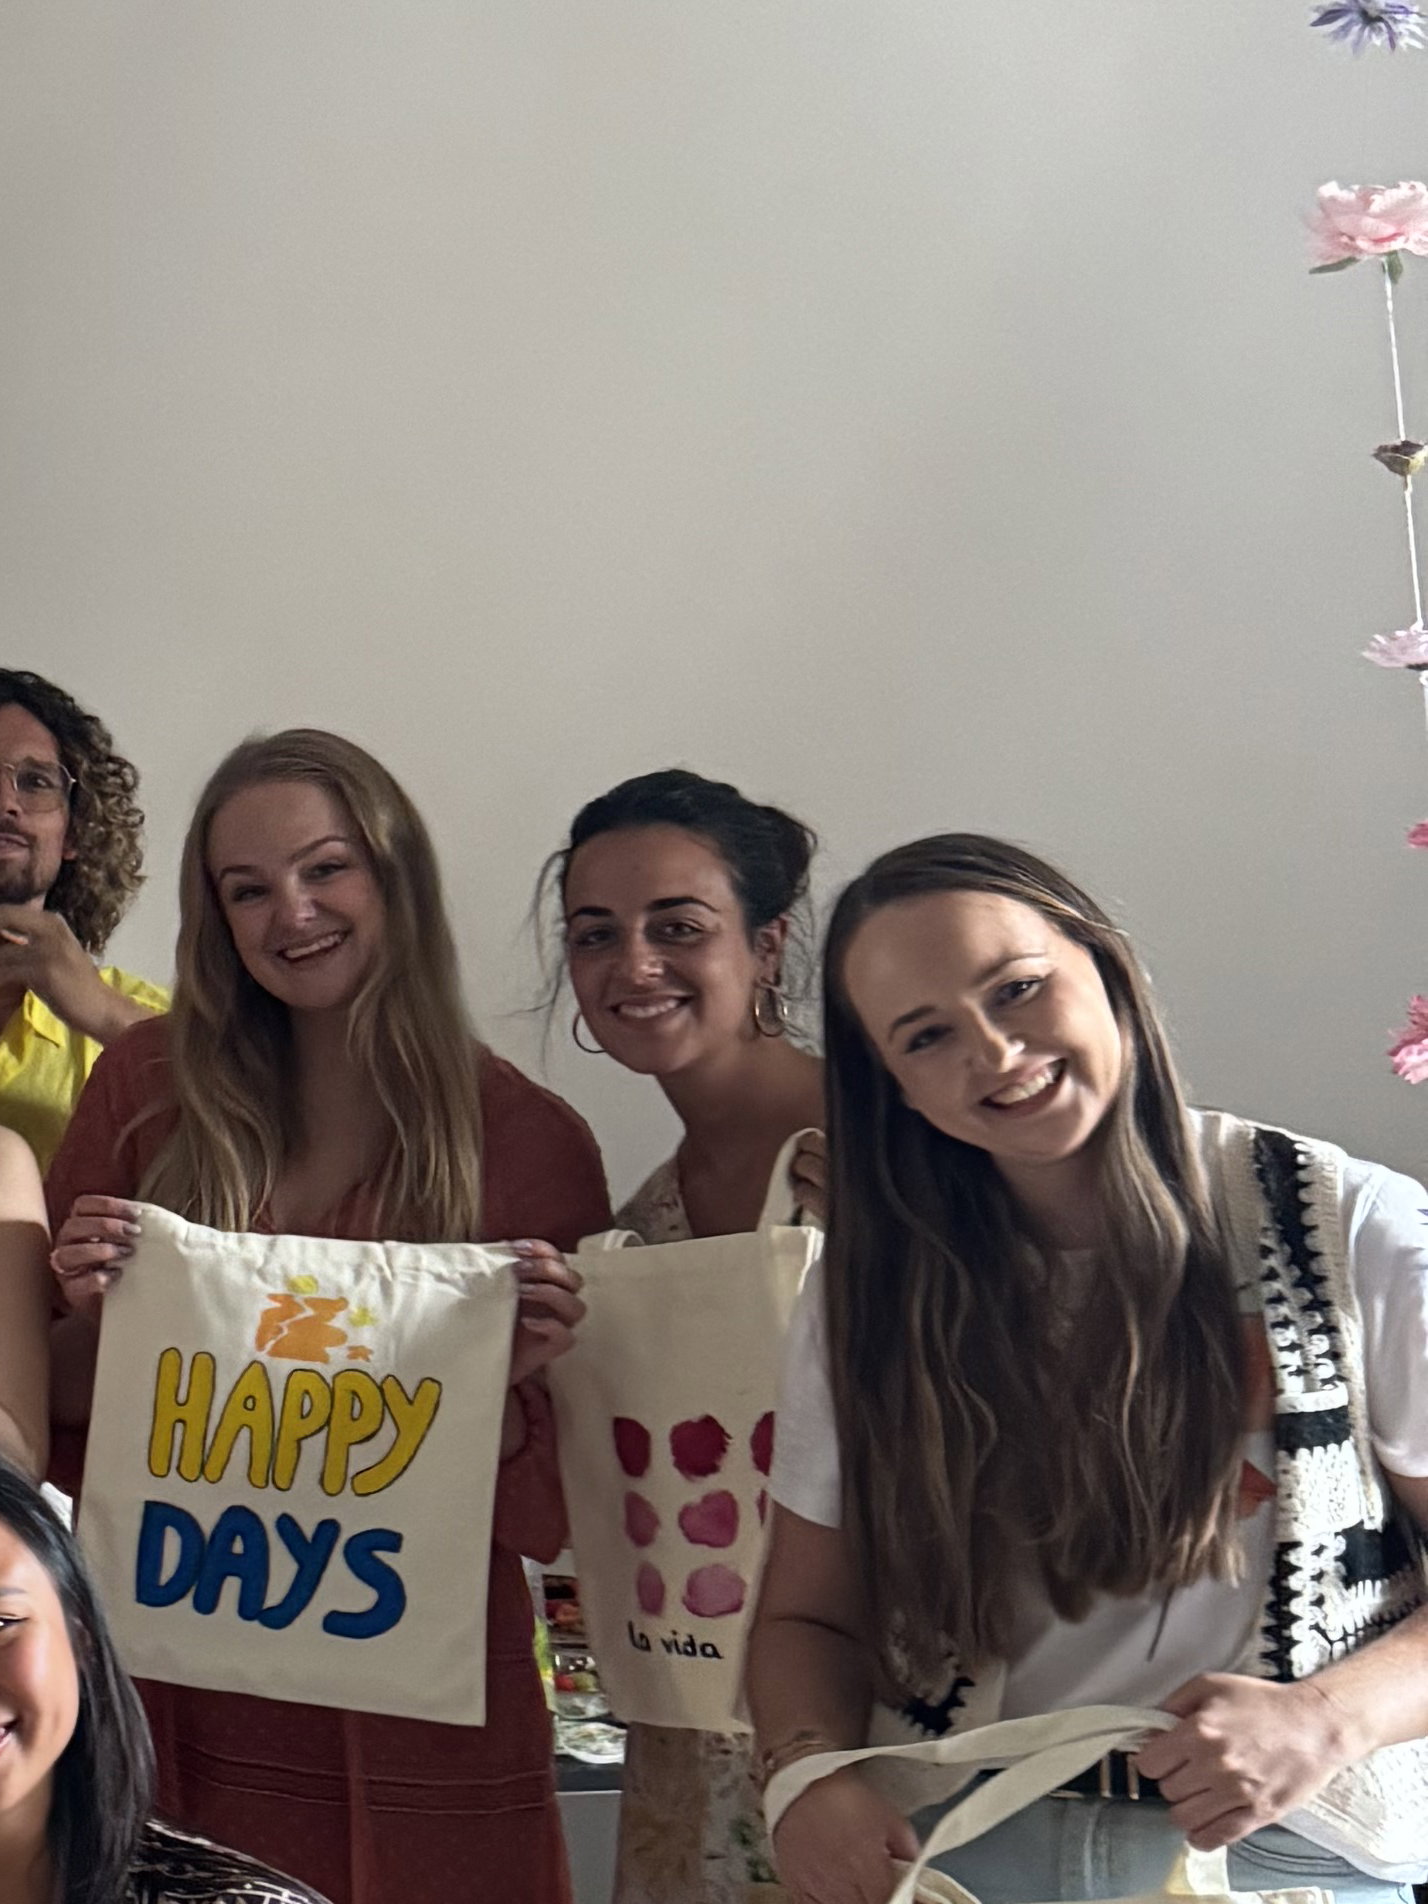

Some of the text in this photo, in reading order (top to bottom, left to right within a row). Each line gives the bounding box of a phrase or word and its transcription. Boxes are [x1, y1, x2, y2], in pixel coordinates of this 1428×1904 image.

[148, 1347, 442, 1497] HAPPY
[136, 1500, 407, 1640] DAYS
[627, 1620, 724, 1660] la vida
